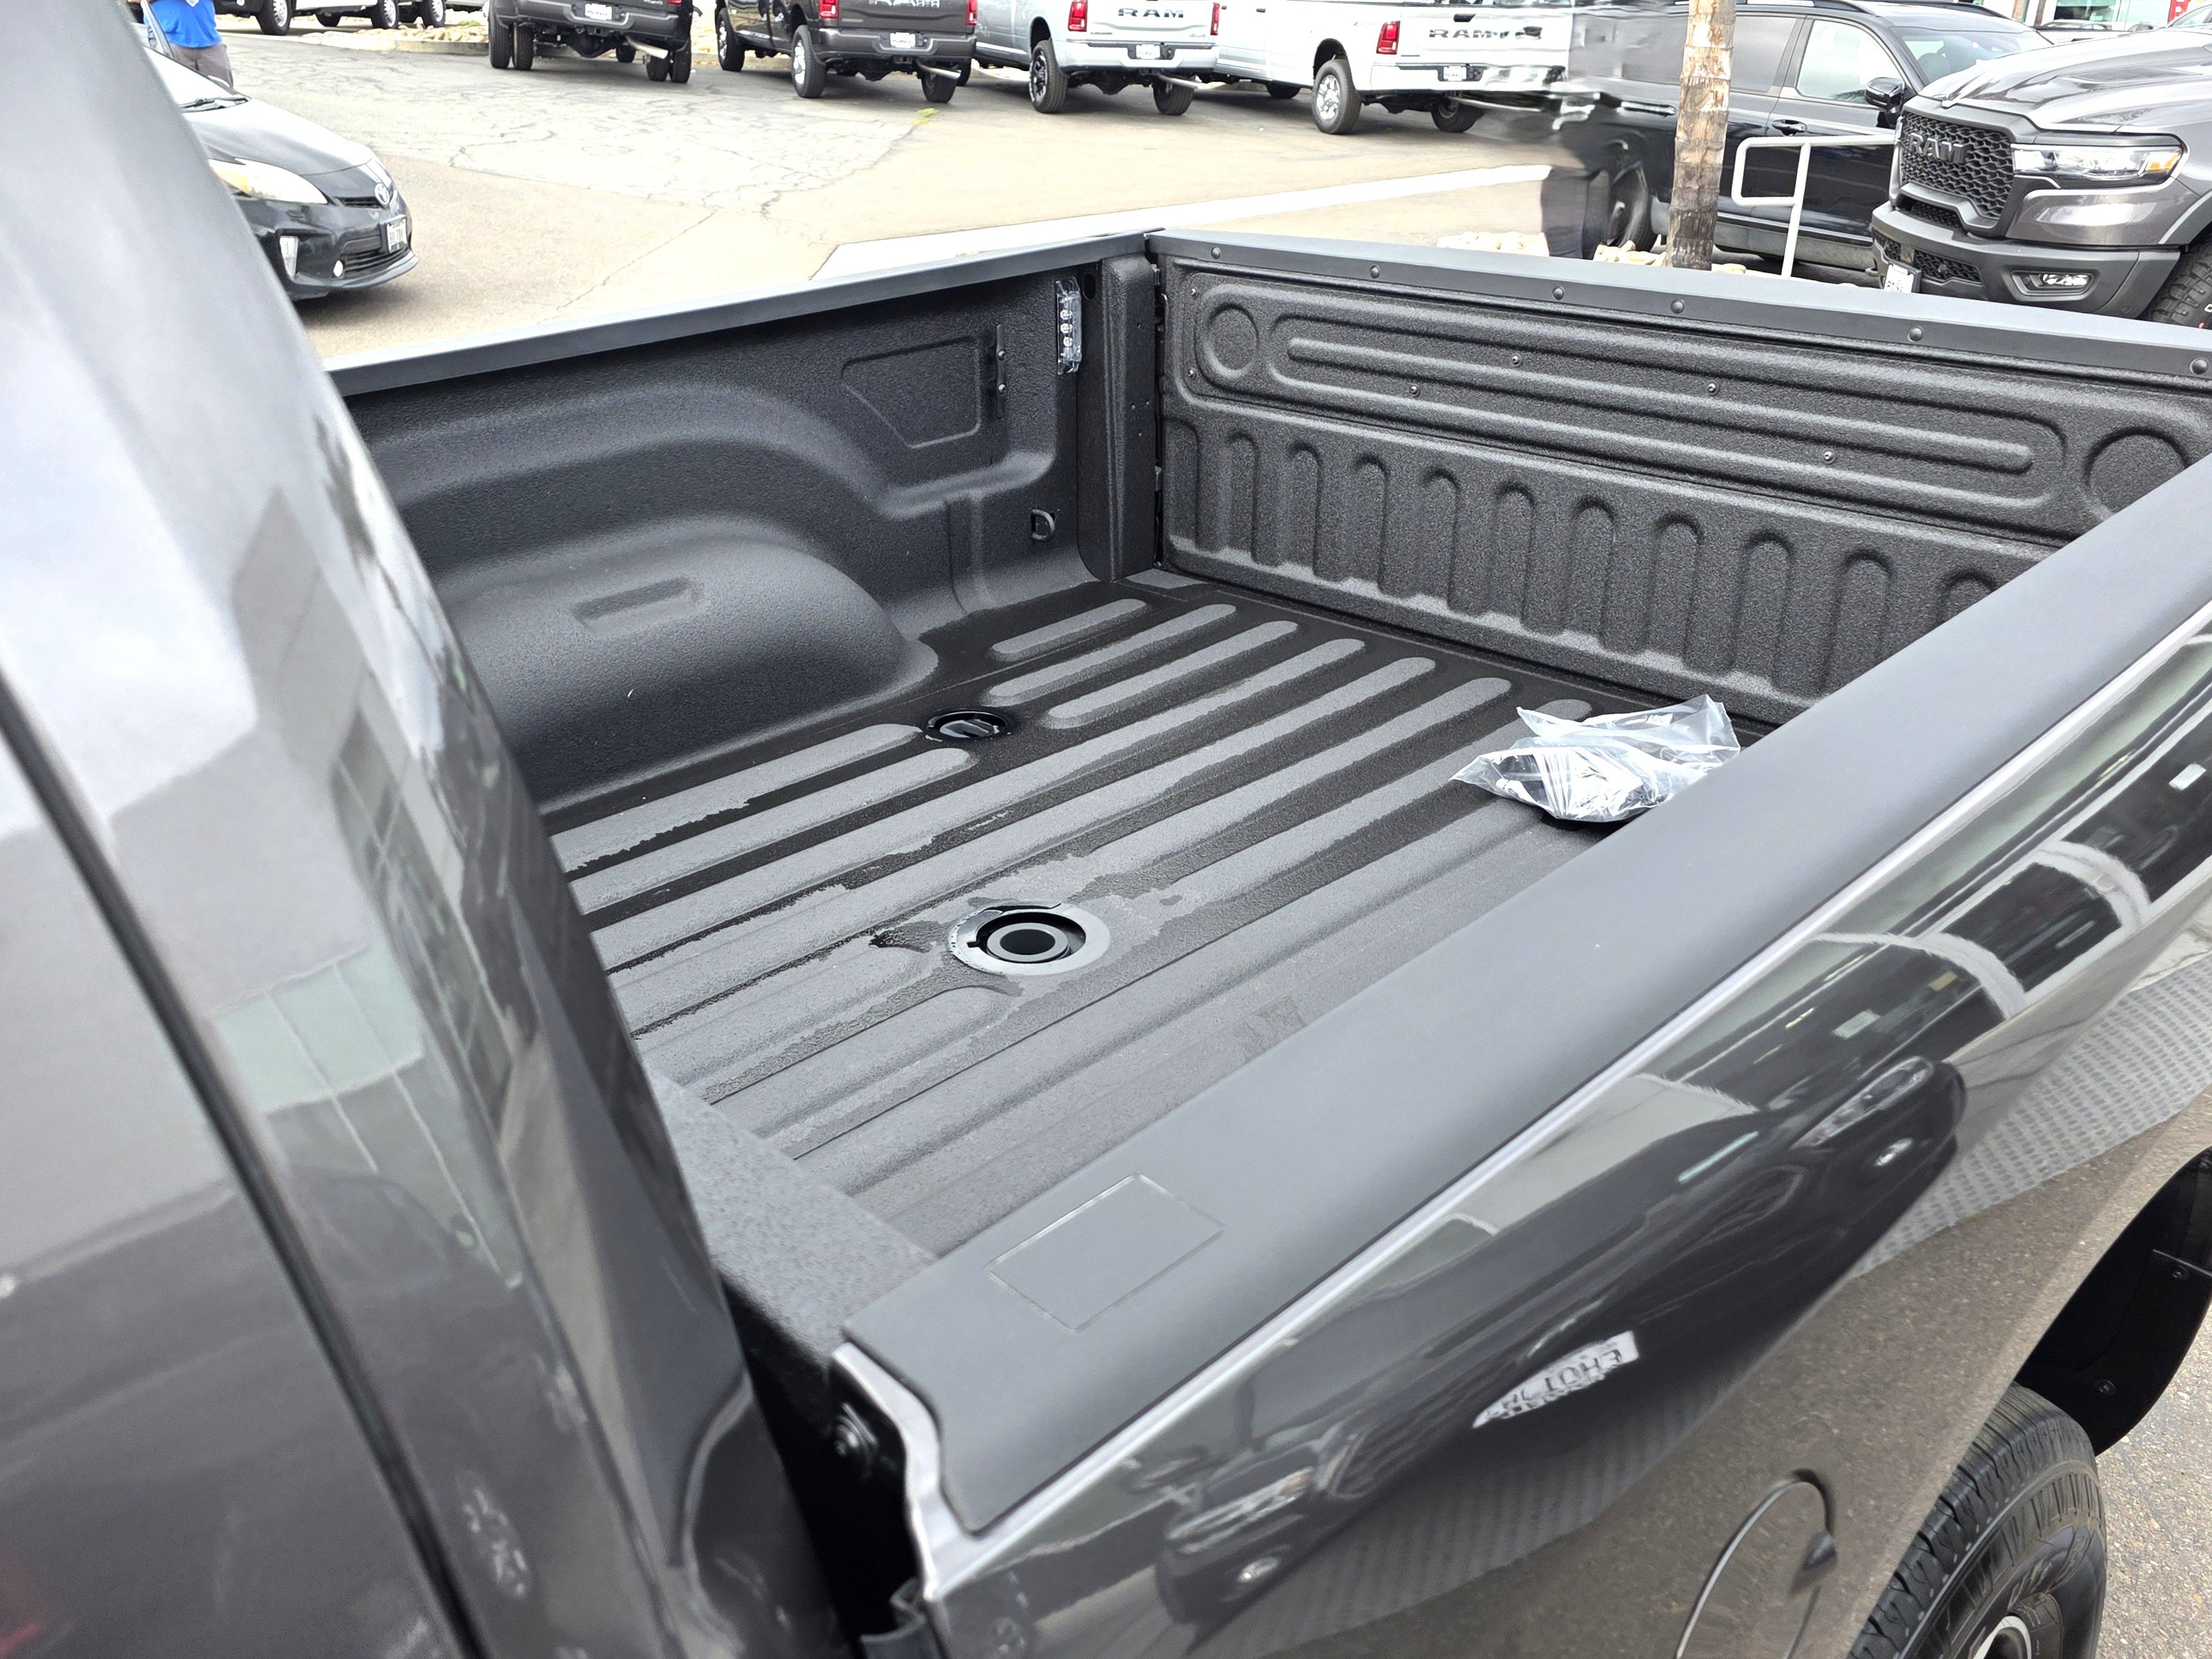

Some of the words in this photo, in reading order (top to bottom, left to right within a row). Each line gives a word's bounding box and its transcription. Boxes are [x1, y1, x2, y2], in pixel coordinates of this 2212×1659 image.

[1118, 8, 1183, 18] RAM
[1429, 29, 1491, 38] RAM
[1909, 132, 1968, 164] RAM
